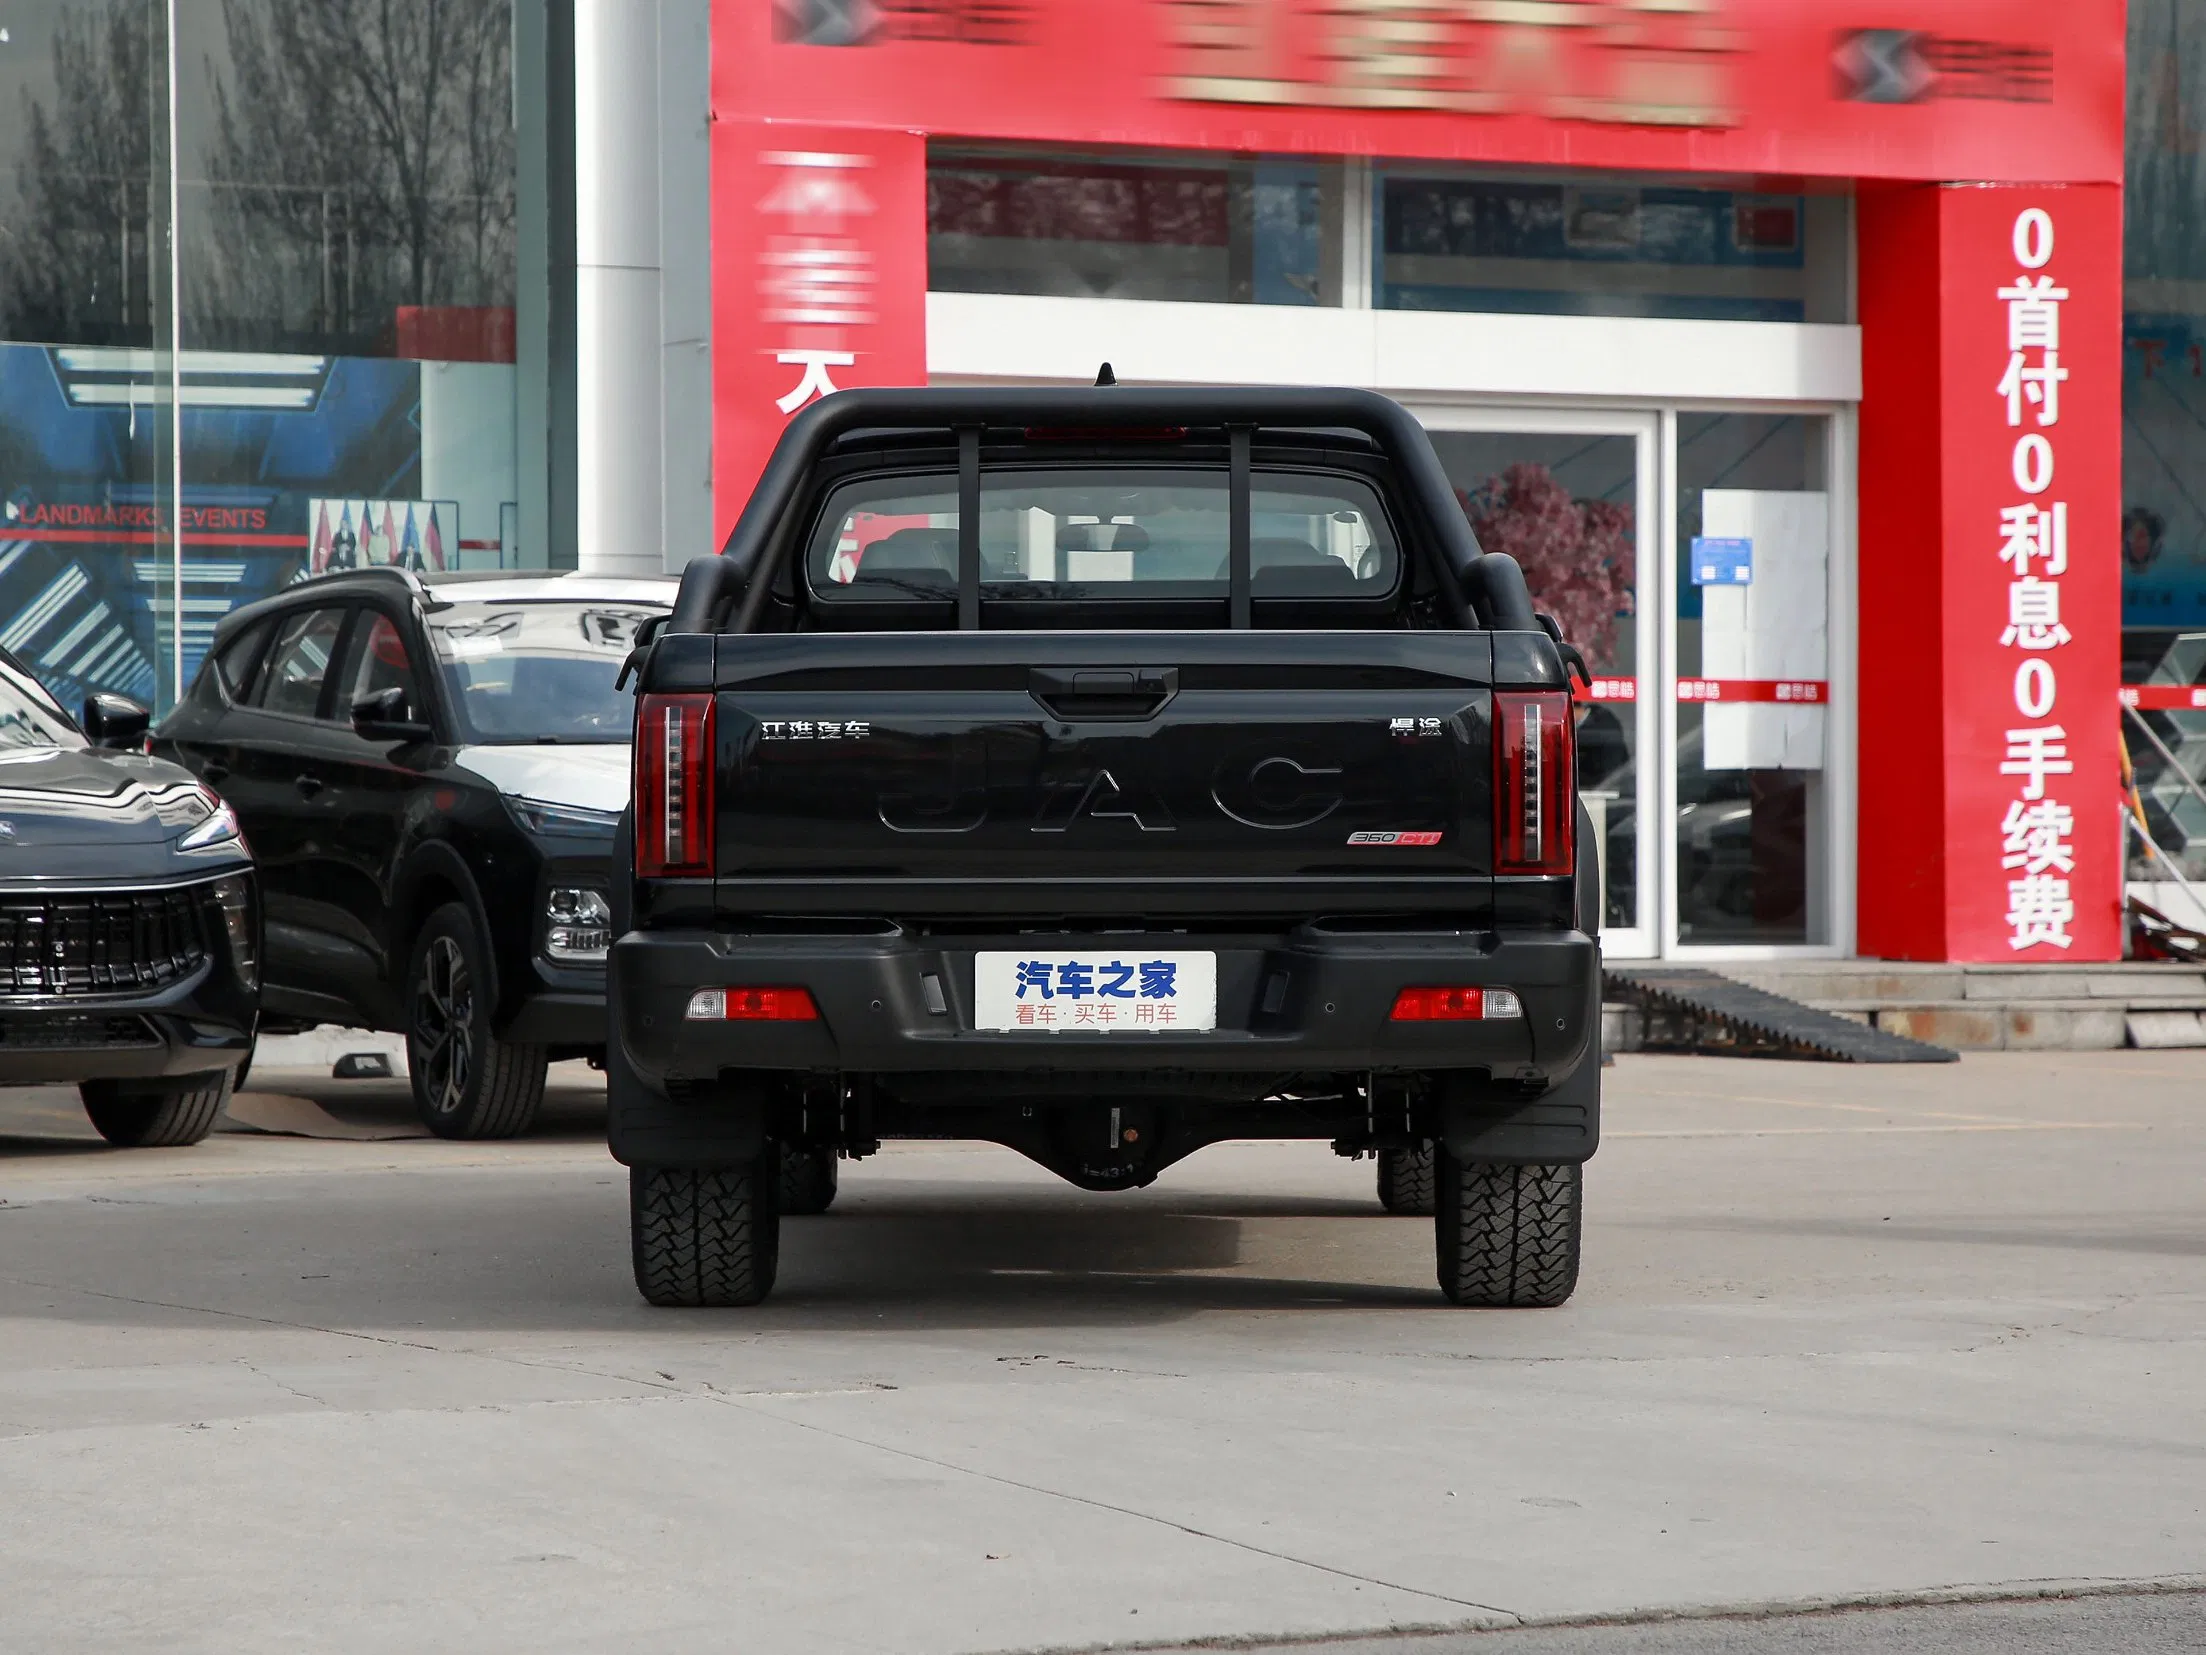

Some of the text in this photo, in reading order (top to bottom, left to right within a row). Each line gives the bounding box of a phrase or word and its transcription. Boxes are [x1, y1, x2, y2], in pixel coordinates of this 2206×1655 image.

[179, 508, 266, 529] EVENTS
[1996, 207, 2075, 950] 0首付0利息0手续费
[761, 720, 870, 740] 江淮汽车
[878, 738, 1344, 834] JAC
[1015, 960, 1177, 999] 汽车之家
